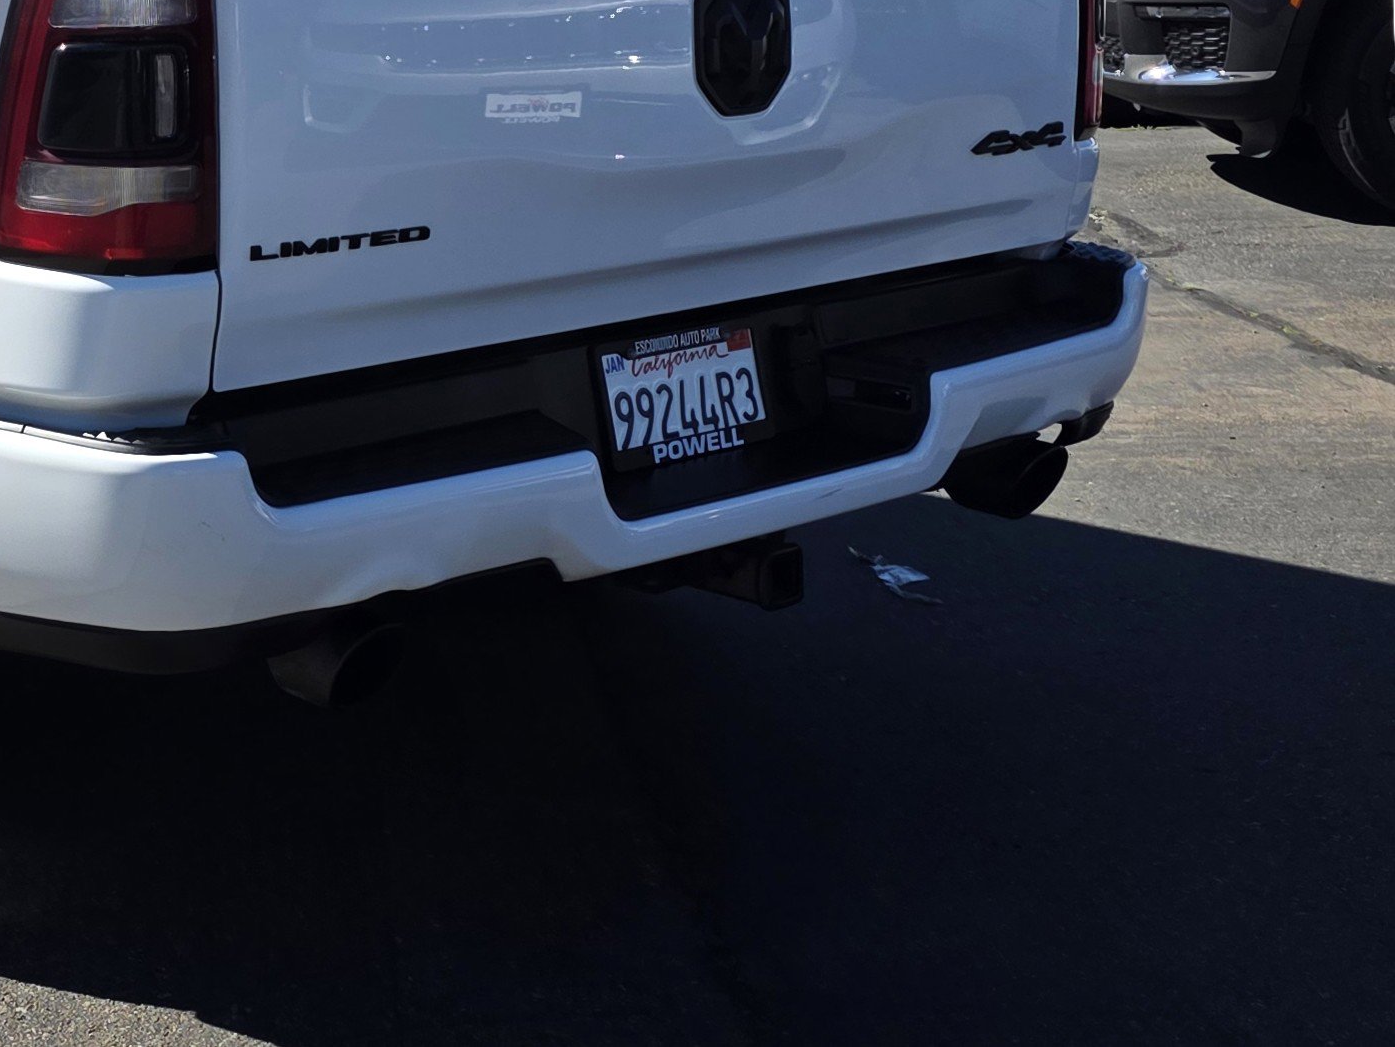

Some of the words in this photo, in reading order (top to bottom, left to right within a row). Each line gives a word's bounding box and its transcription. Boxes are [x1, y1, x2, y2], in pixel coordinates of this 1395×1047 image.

[249, 225, 431, 262] LIMITED
[680, 330, 700, 346] AUTO
[701, 326, 721, 343] PARK
[605, 356, 625, 374] JAN
[630, 344, 729, 378] California
[614, 367, 759, 451] 99244R3
[652, 428, 745, 464] POWELL
